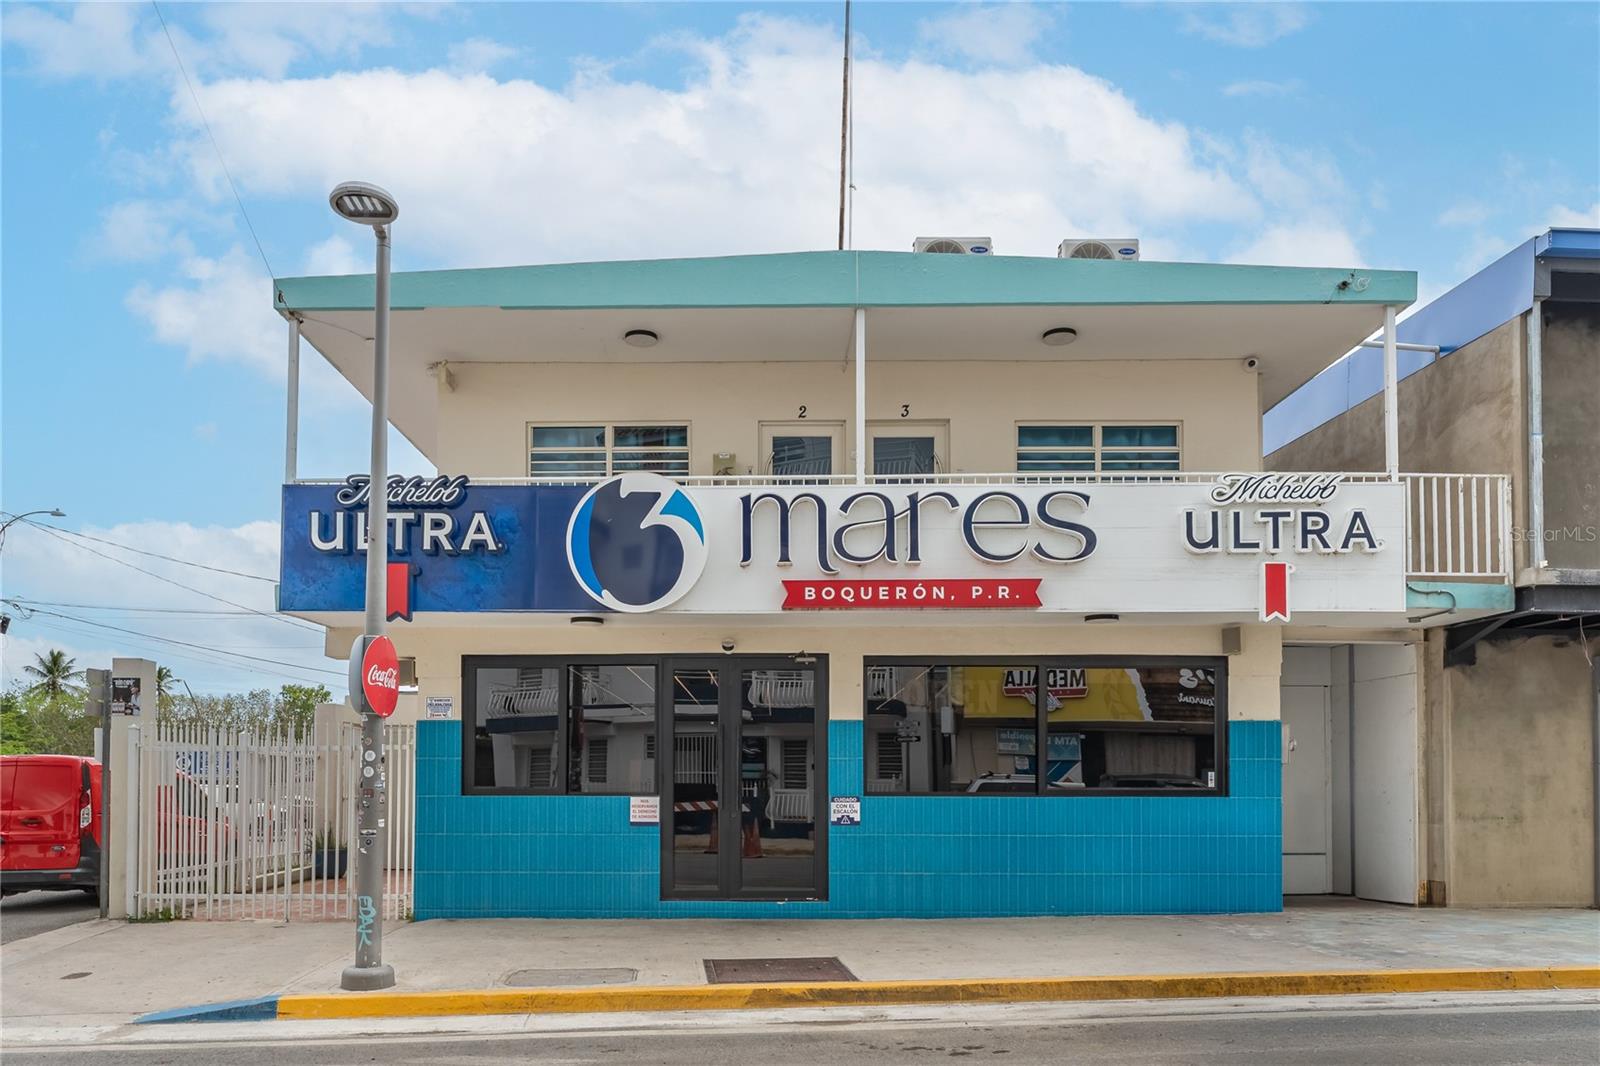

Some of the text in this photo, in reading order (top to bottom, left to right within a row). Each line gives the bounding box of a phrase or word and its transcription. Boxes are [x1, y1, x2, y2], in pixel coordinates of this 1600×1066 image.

[798, 405, 807, 419] 2
[901, 404, 910, 417] 3
[1211, 474, 1344, 503] Michelob
[1185, 511, 1378, 549] ULTRA
[597, 472, 1098, 613] 3 mares
[804, 583, 1021, 602] BOQUERÓN, P.R.
